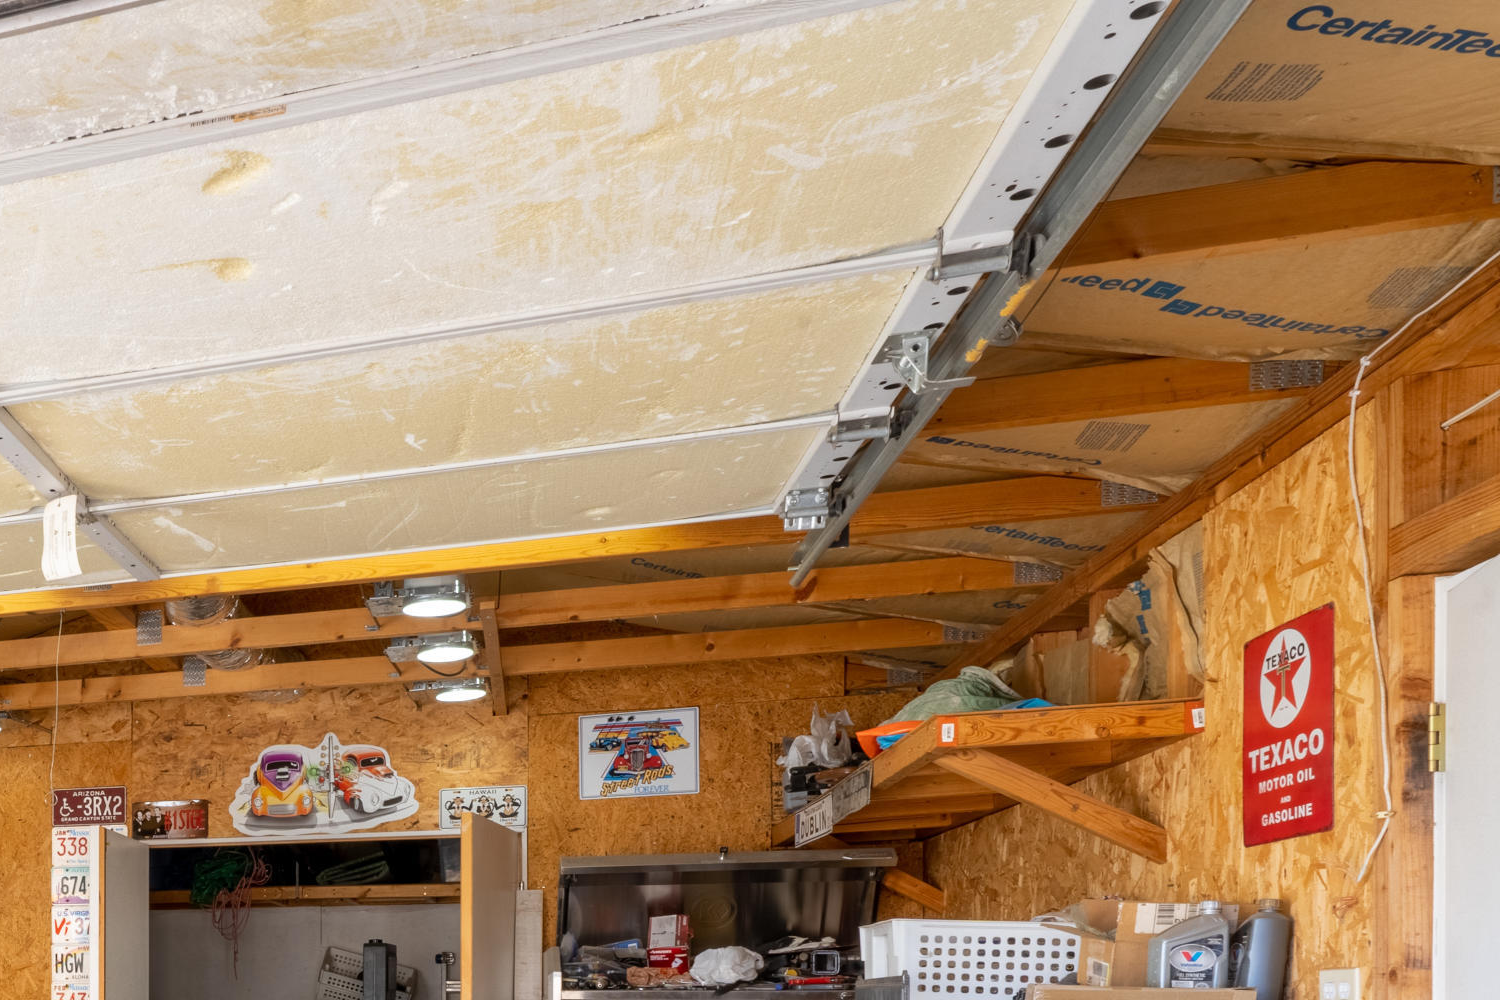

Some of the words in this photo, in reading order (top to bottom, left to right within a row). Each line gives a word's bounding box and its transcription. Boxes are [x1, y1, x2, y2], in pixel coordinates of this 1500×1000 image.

[1265, 642, 1306, 671] TEXACO
[1248, 727, 1325, 774] TEXACO
[601, 775, 641, 797] Street
[641, 765, 674, 785] Rods
[633, 784, 670, 794] FOREVER
[1258, 771, 1294, 794] MOTOR
[1296, 767, 1316, 784] OIL
[1280, 795, 1292, 804] AND
[800, 809, 828, 840] DUBLIN
[1261, 803, 1313, 827] GASOLINE
[57, 837, 88, 856] 338
[55, 952, 84, 974] HGW
